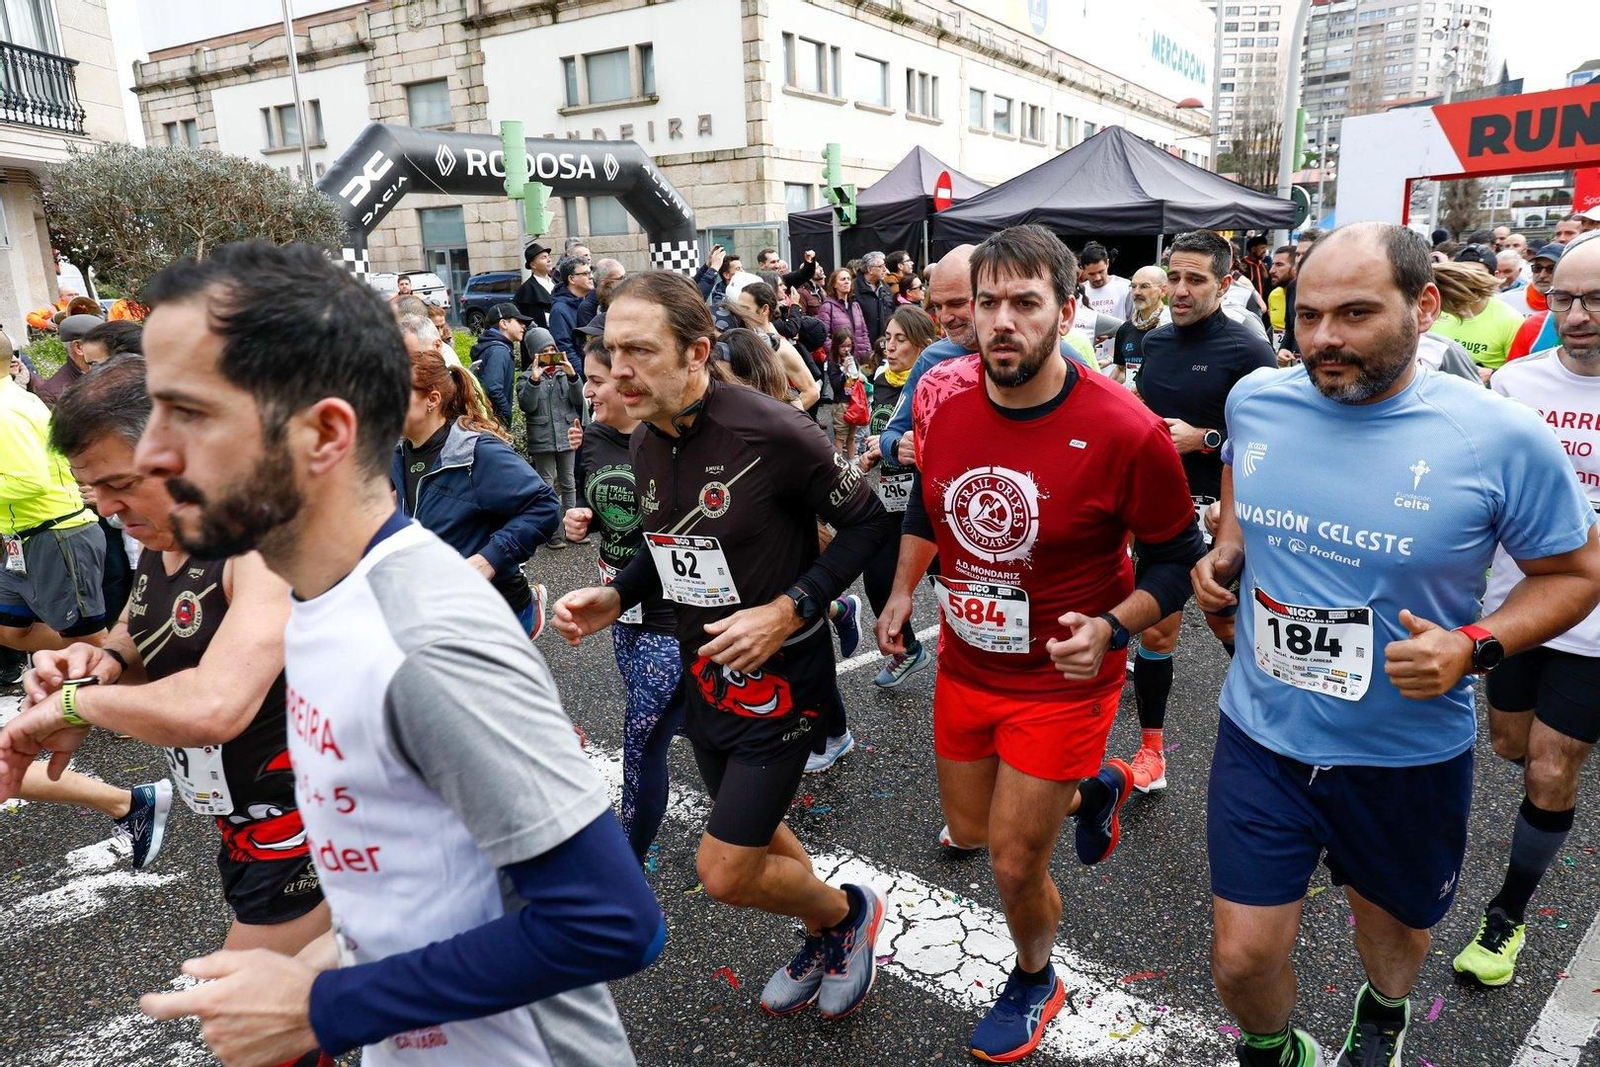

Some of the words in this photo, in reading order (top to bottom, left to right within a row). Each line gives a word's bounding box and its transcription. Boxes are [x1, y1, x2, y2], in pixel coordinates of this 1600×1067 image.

[1152, 30, 1206, 86] MERCADONA
[642, 164, 694, 220] ALPINE
[1192, 364, 1208, 372] GORE
[881, 483, 908, 499] 296
[958, 478, 992, 509] TRAIL
[996, 481, 1024, 528] ORIXES
[1394, 497, 1430, 511] Celta
[960, 516, 1013, 547] MONDARIZ
[1317, 521, 1414, 556] CELESTE
[671, 550, 701, 579] 62
[1268, 535, 1281, 547] BY
[1309, 545, 1360, 568] Profand
[970, 564, 1020, 580] MONDARIZ
[948, 593, 1006, 627] 584
[1268, 617, 1343, 658] 184
[333, 786, 356, 814] 5
